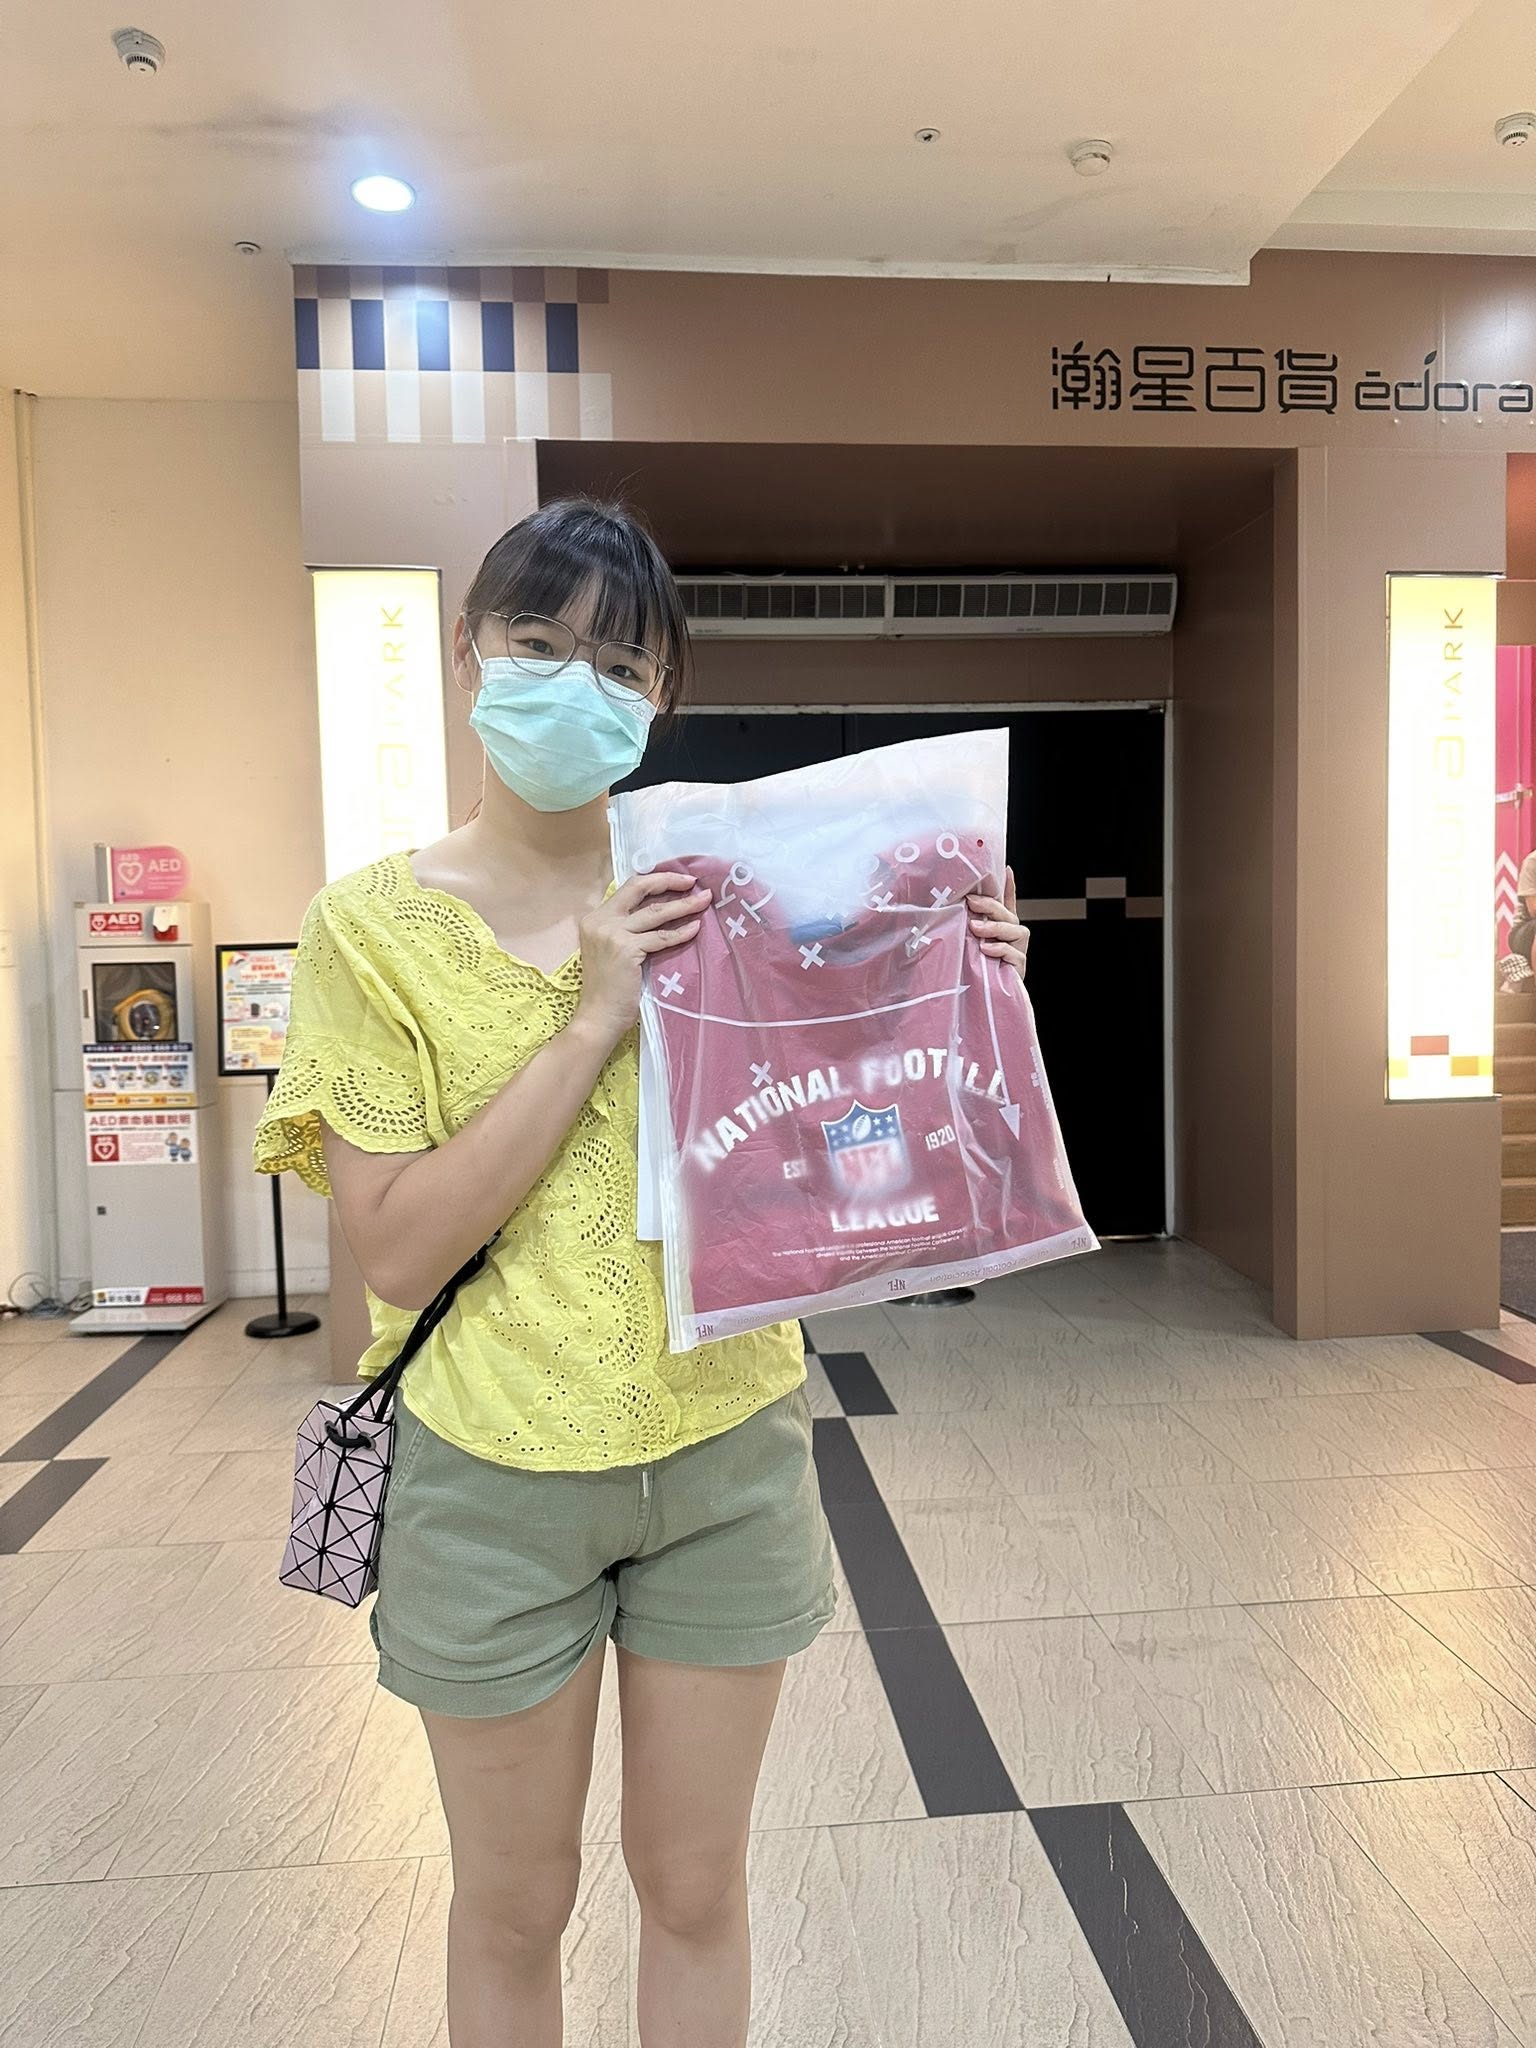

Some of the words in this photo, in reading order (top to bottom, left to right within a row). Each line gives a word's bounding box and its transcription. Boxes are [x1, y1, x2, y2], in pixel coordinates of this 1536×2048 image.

[1051, 340, 1338, 415] 瀚星百貨
[381, 604, 406, 728] PARK
[1442, 607, 1464, 721] PARK
[148, 858, 182, 873] AED
[107, 913, 141, 925] AED
[695, 1066, 852, 1172] NATIONAL
[924, 1124, 957, 1151] 1920
[830, 1195, 940, 1233] LEAGUE
[1070, 1237, 1088, 1250] NFL
[887, 1278, 907, 1292] NFL
[929, 1269, 982, 1284] Association
[695, 1323, 715, 1339] NFL
